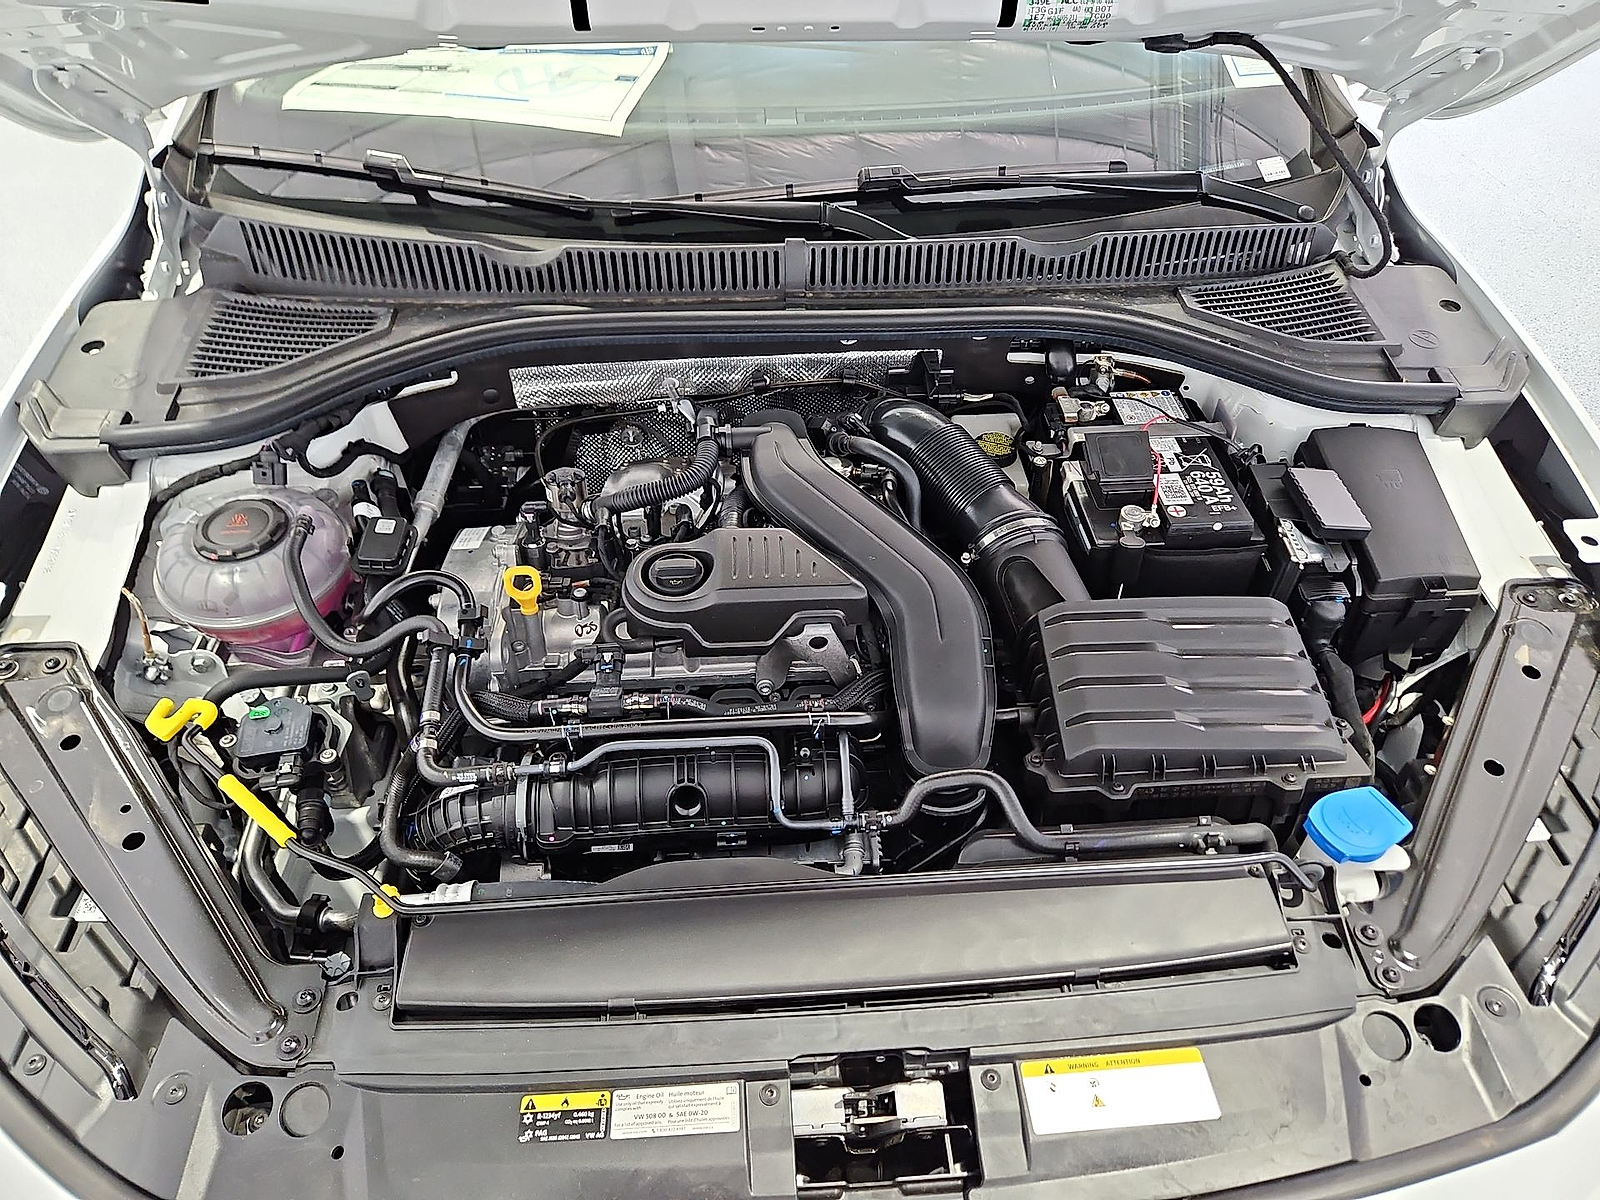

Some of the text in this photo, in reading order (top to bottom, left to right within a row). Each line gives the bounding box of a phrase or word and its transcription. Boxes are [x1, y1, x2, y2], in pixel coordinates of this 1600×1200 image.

[1190, 470, 1213, 492] 640
[1206, 472, 1233, 502] 59Ah
[1201, 495, 1220, 505] A
[1067, 1058, 1141, 1070] WARNING ATTENTION
